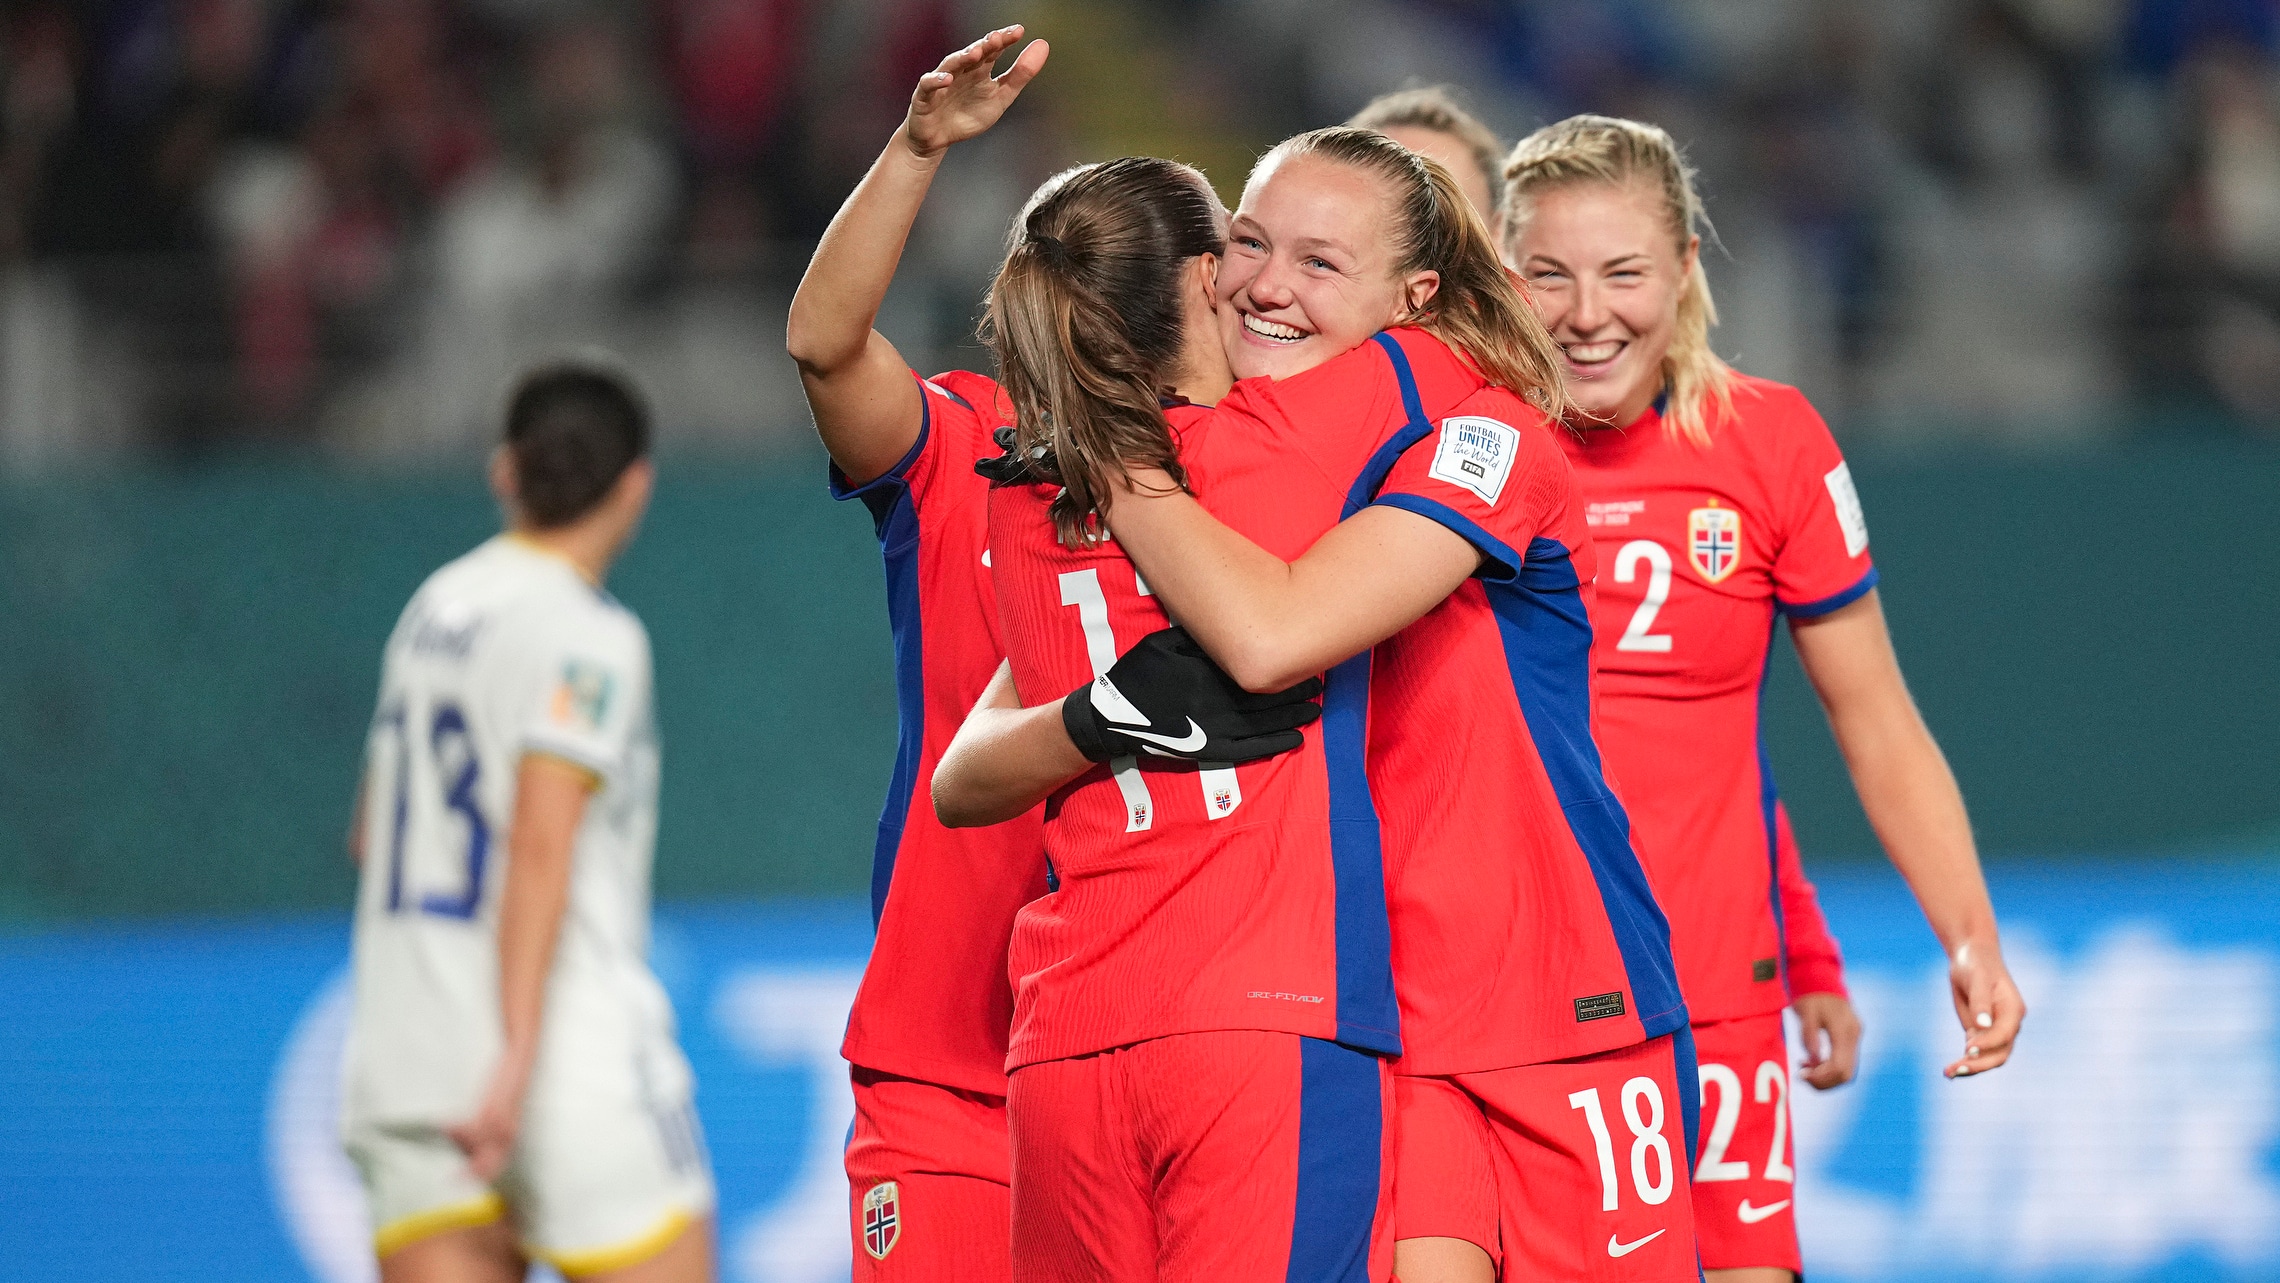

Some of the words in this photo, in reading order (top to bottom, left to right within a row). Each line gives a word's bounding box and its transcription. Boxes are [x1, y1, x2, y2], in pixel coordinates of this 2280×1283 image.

[1453, 443, 1470, 456] the
[1471, 447, 1500, 471] World
[1459, 431, 1501, 457] UNITES
[1460, 424, 1501, 444] FOOTBALL
[1463, 461, 1483, 477] FIFA
[1058, 566, 1243, 833] 1
[376, 693, 492, 920] 13
[1568, 1075, 1674, 1212] 18
[1694, 1060, 1794, 1183] 22
